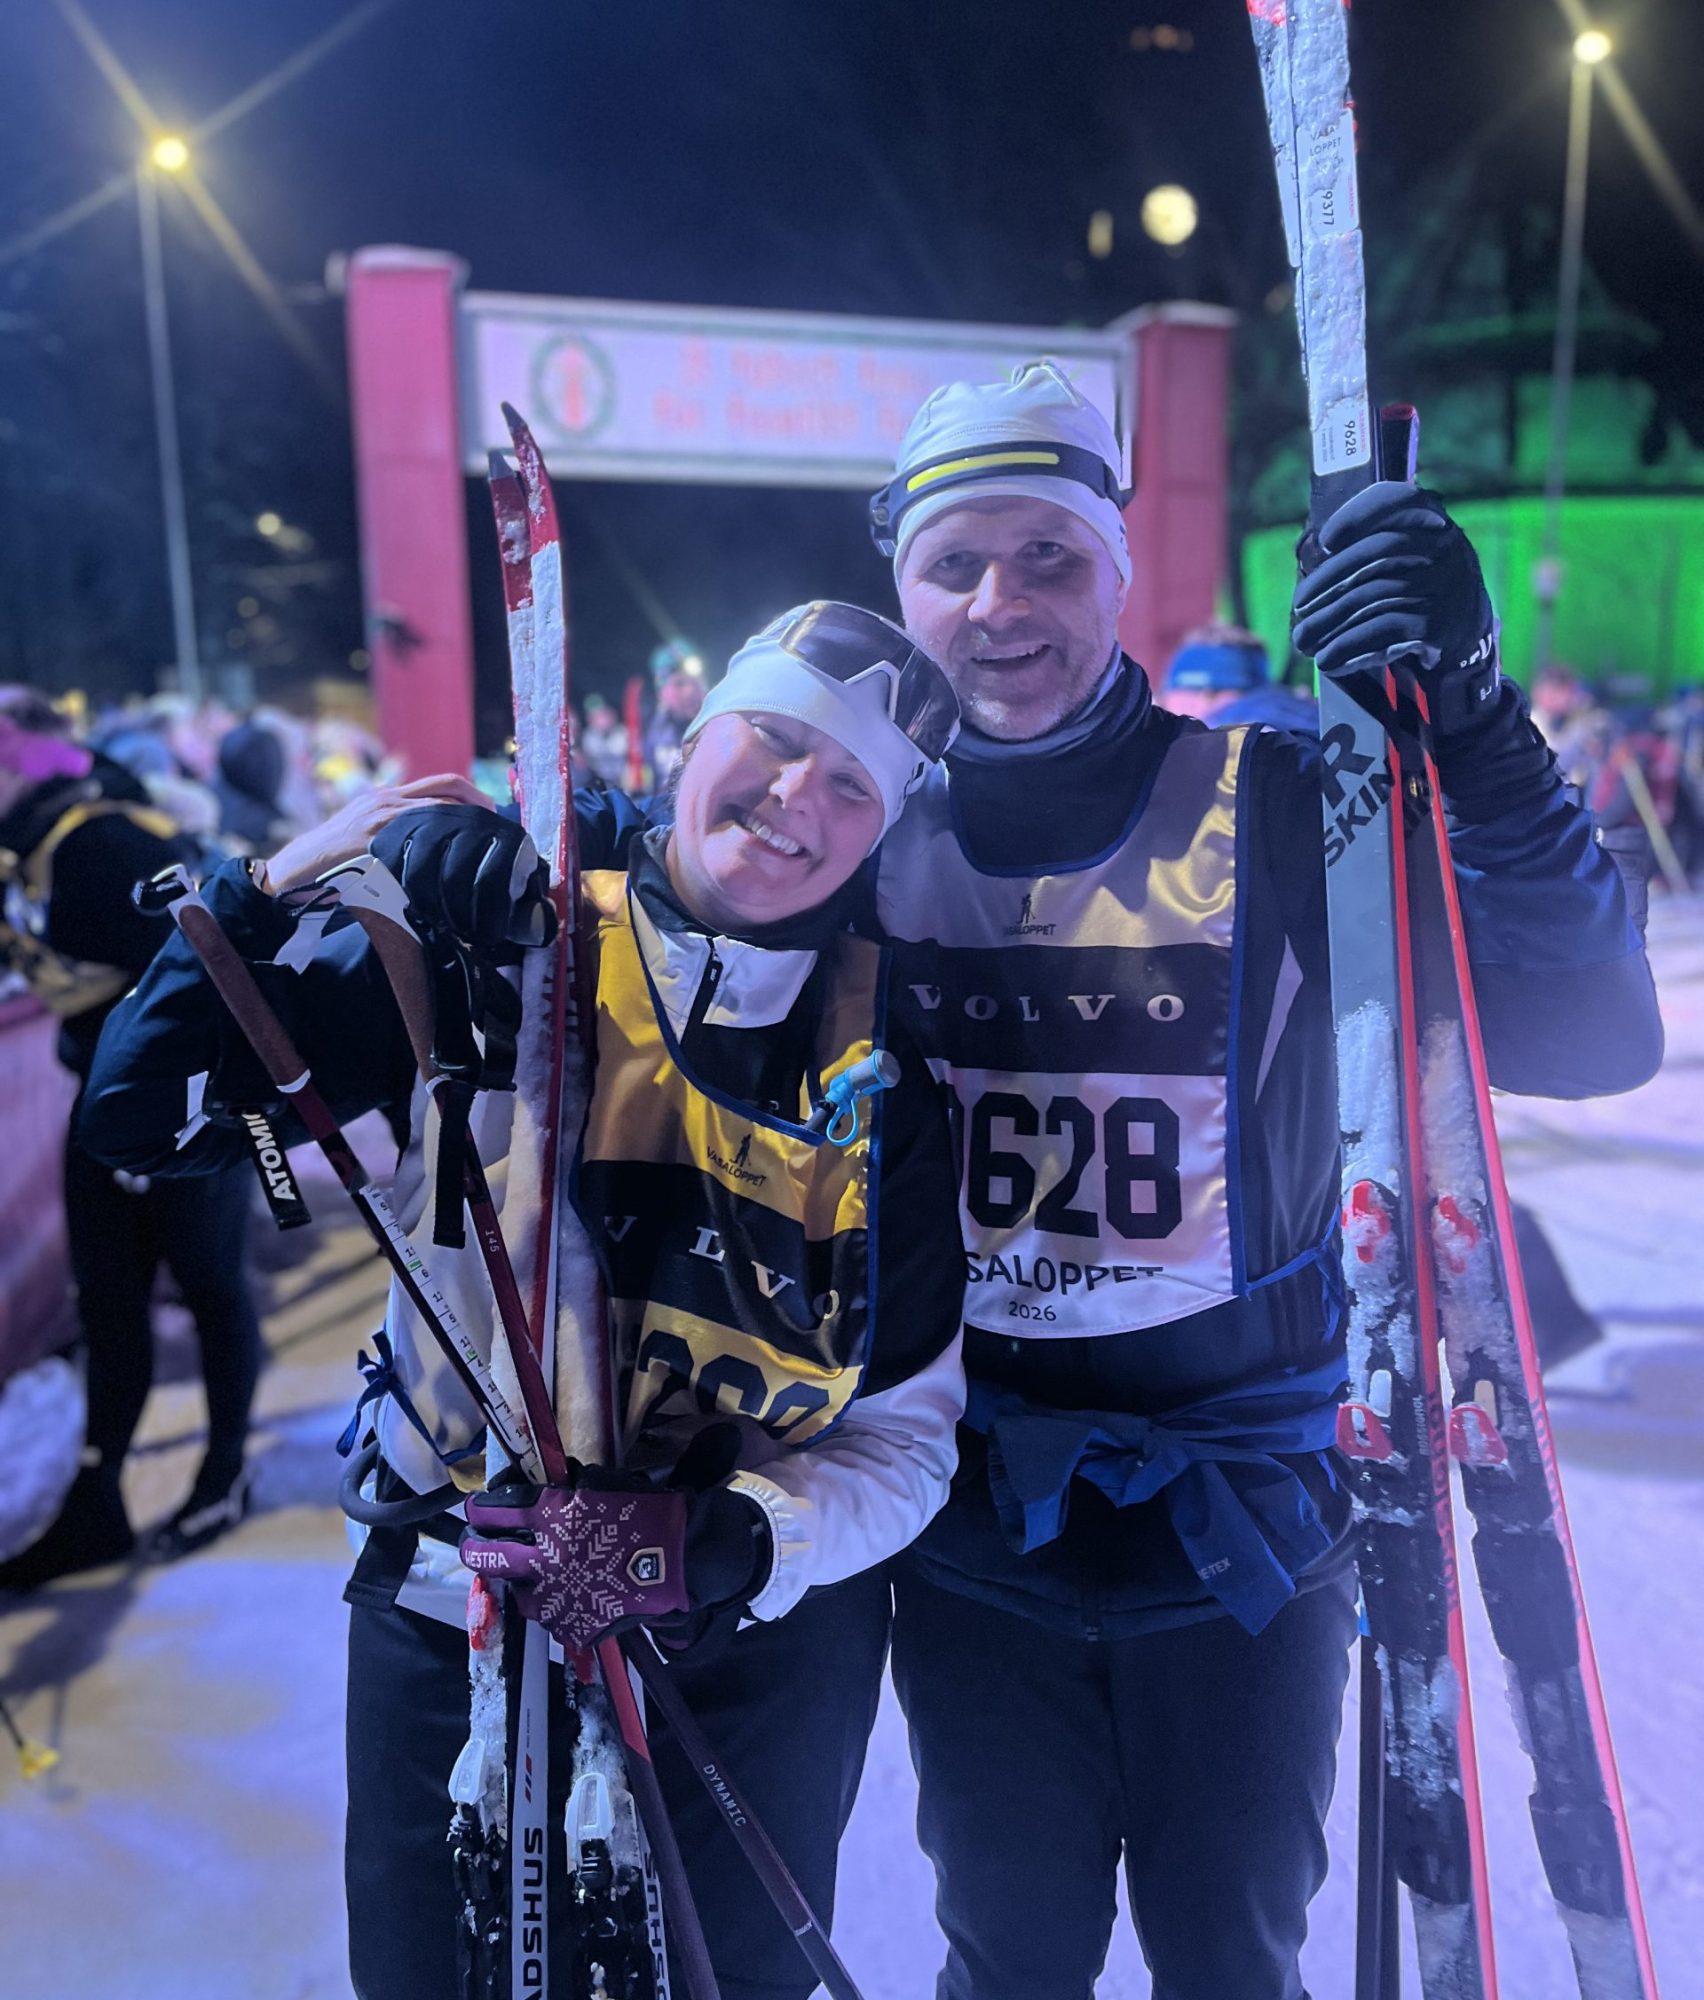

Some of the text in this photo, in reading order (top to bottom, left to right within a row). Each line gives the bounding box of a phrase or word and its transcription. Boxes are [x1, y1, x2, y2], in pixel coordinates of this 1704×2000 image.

[1309, 137, 1343, 157] LOPPET
[1322, 190, 1335, 226] 9377
[1344, 419, 1357, 457] 9628
[908, 984, 1185, 1023] VOLVO
[706, 1145, 767, 1188] VASALOPPET
[949, 1091, 1183, 1240] 628
[485, 1230, 500, 1253] 145
[603, 1215, 840, 1320] VLVO
[963, 1251, 1164, 1296] SALOPPET
[1008, 1301, 1057, 1322] 2026
[1197, 1557, 1231, 1580] E-TEX
[703, 1764, 746, 1827] DYNAMIC
